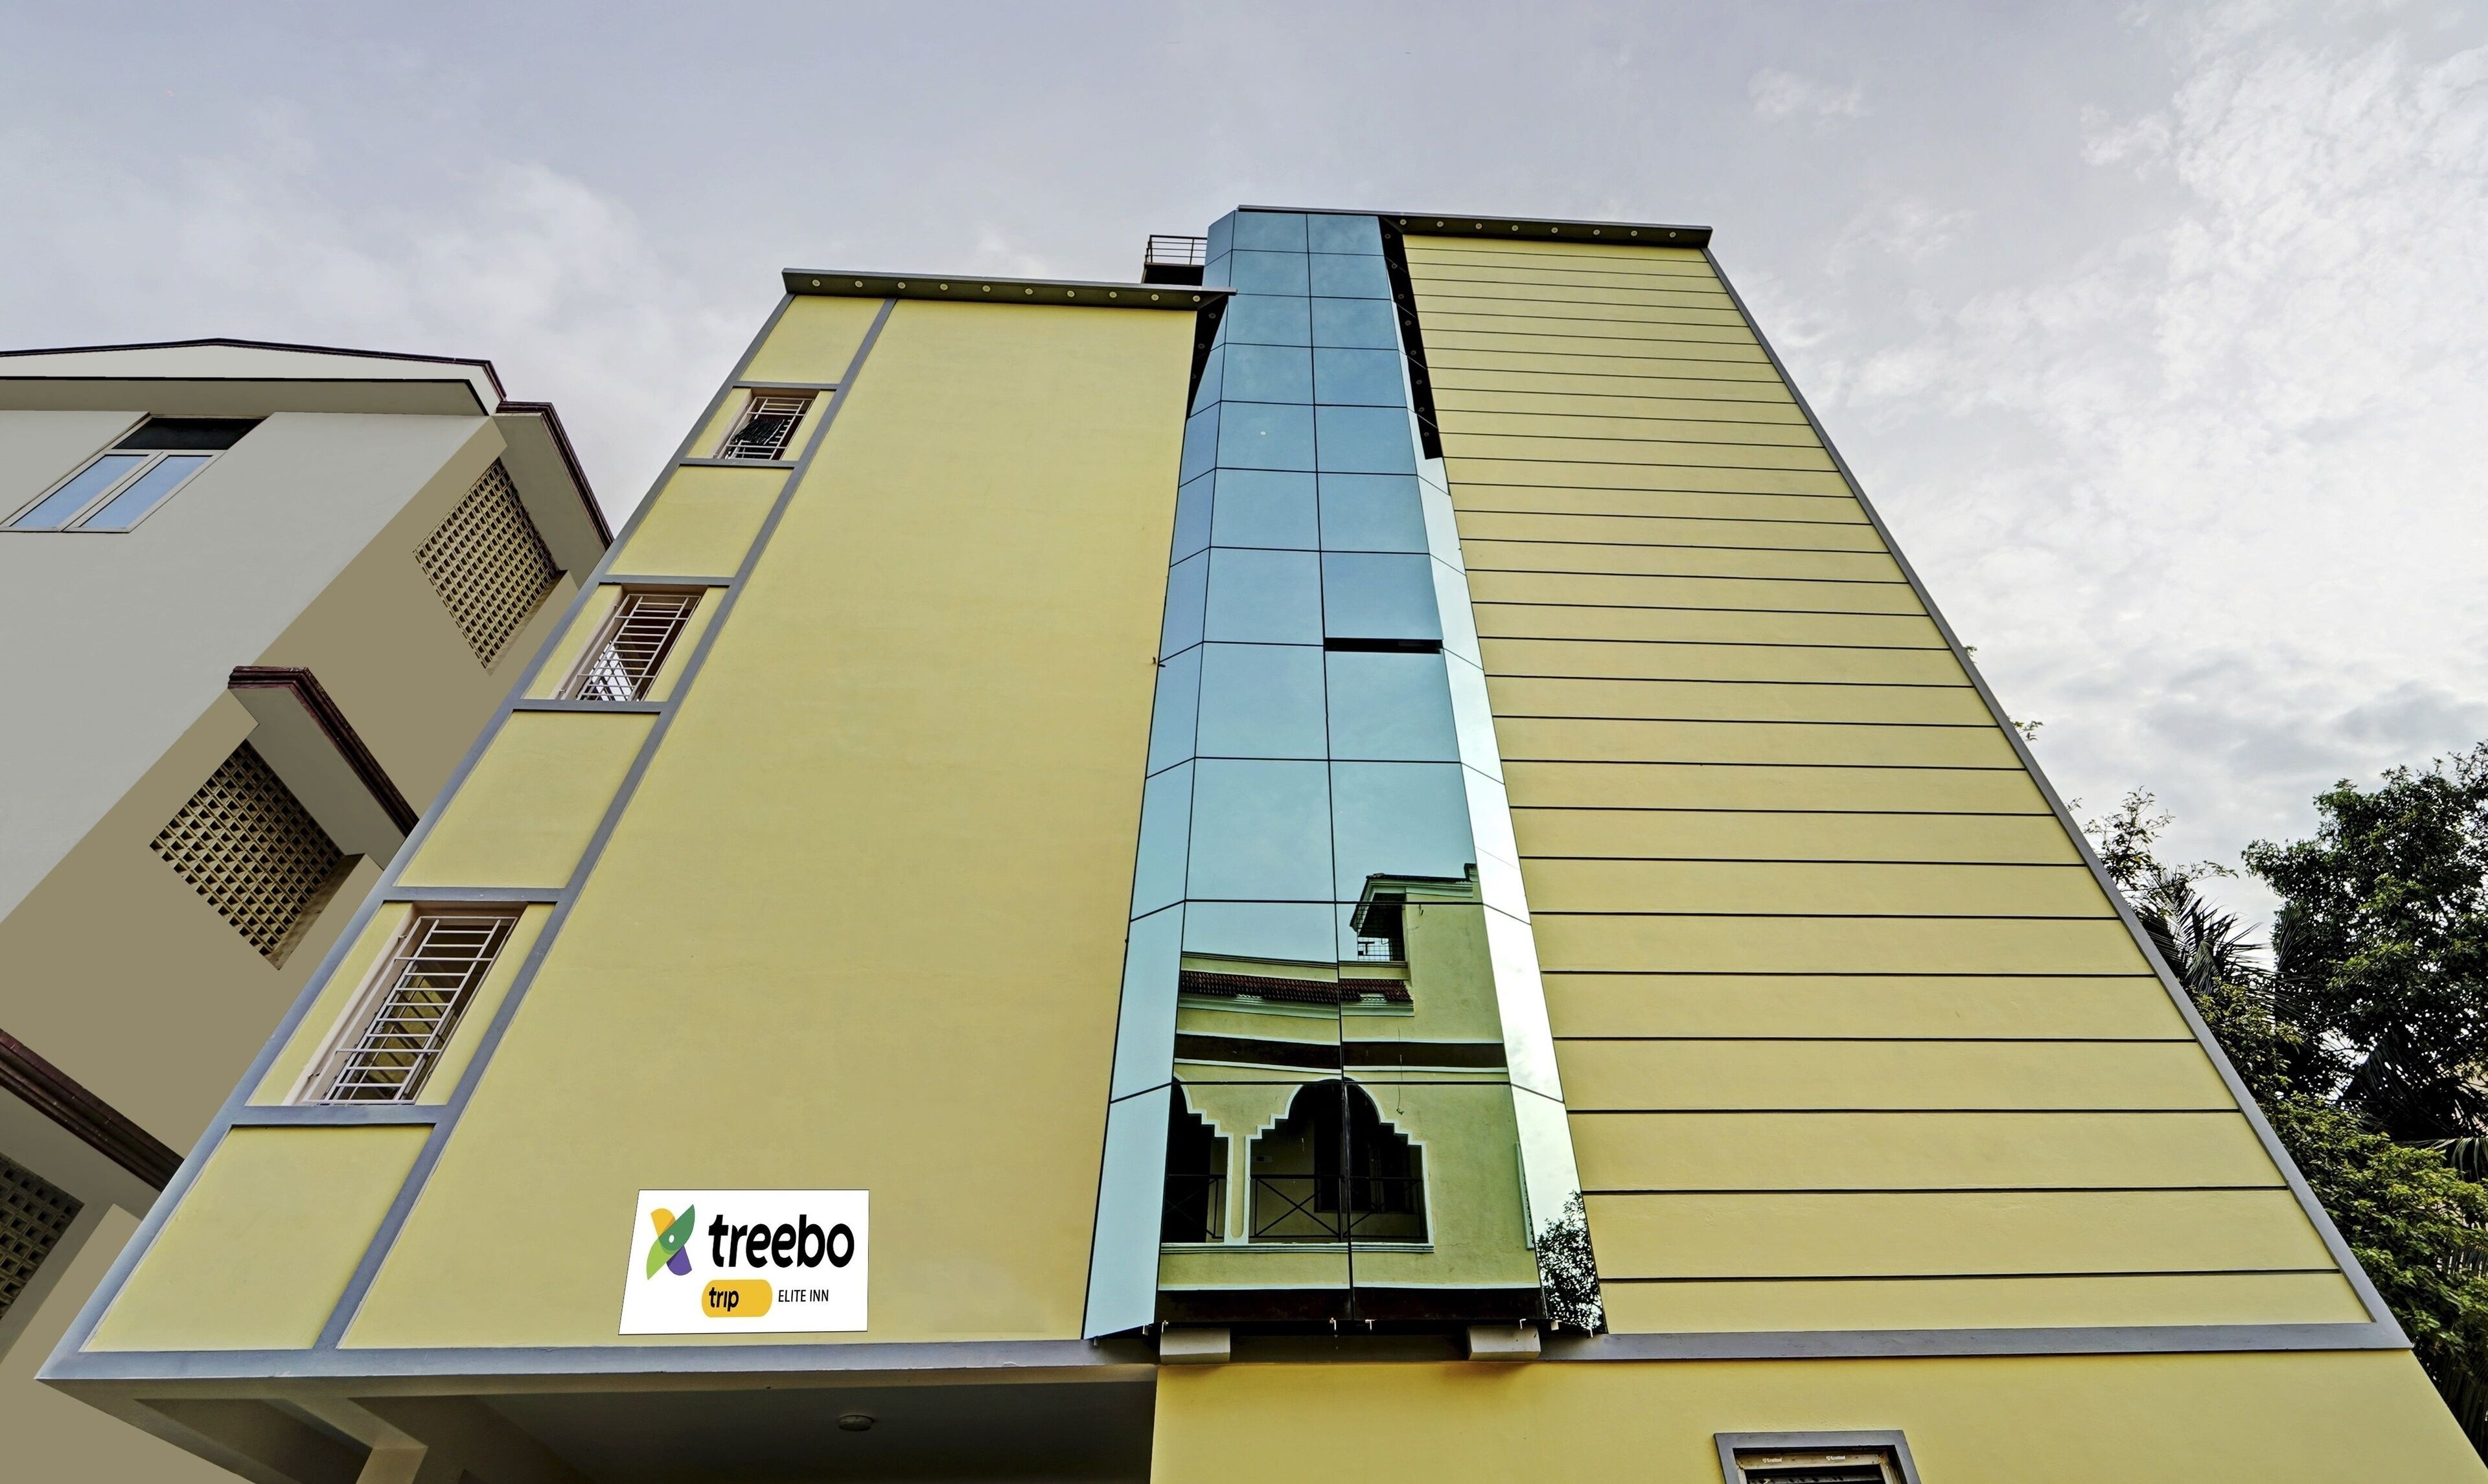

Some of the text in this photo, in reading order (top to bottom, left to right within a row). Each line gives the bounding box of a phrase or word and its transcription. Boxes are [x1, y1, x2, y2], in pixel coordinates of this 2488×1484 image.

[708, 1214, 855, 1268] treebo
[708, 1287, 739, 1312] trip
[778, 1289, 829, 1303] ELITE INN
